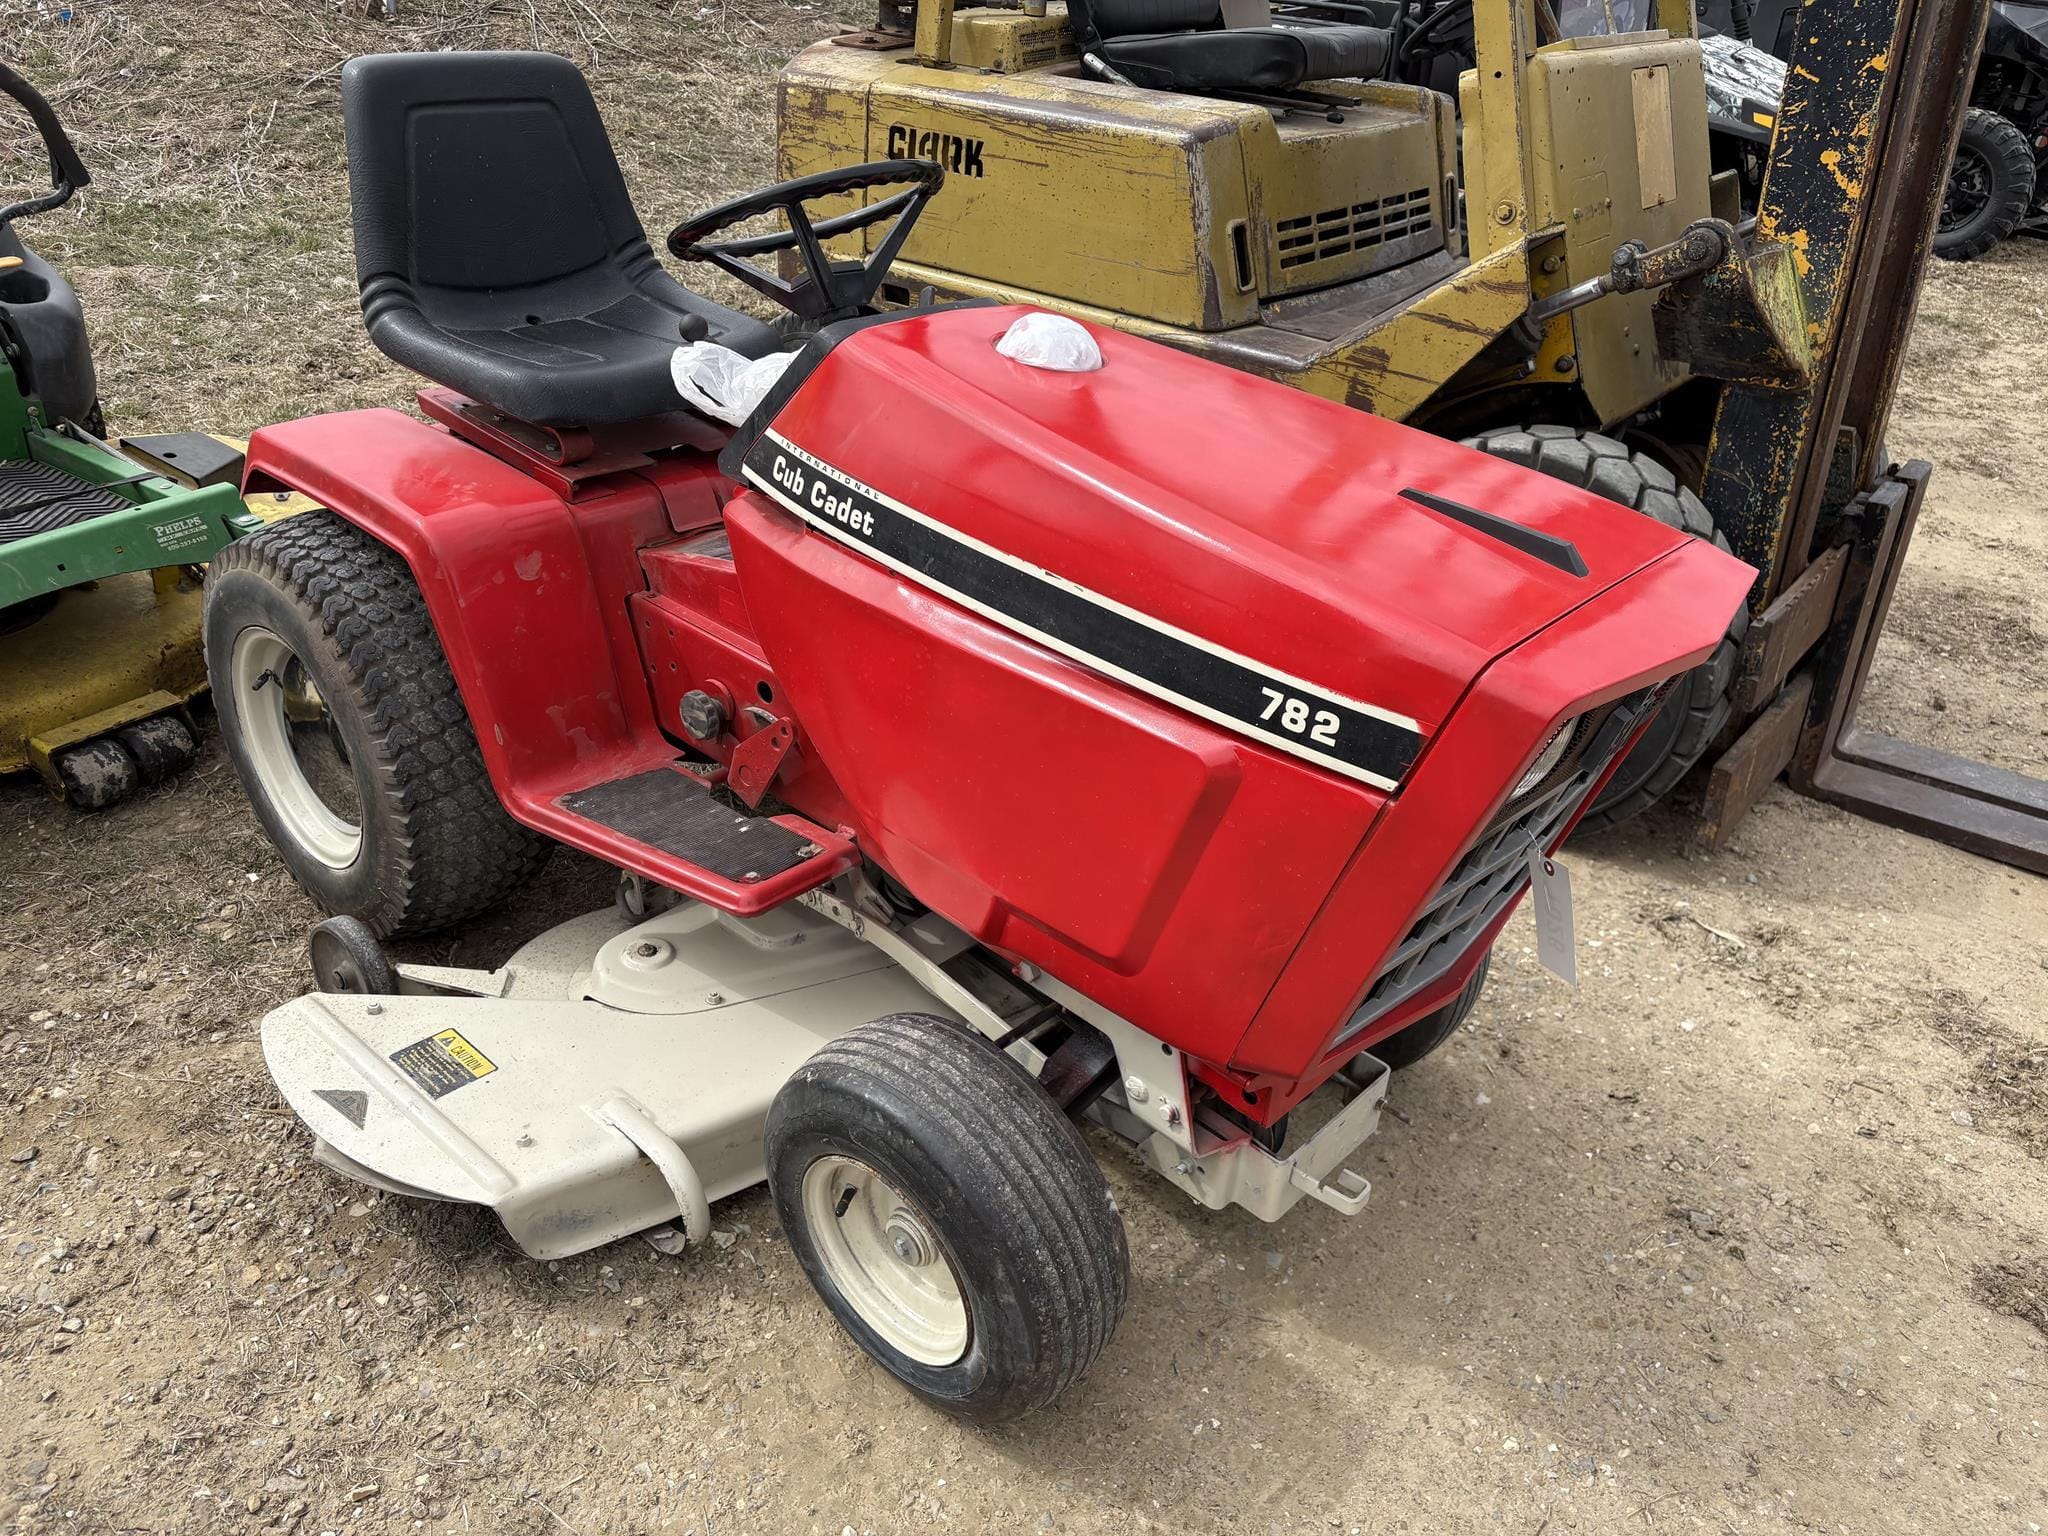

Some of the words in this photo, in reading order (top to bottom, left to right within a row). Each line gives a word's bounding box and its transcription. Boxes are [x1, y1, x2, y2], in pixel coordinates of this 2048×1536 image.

[772, 455, 805, 496] Cub
[810, 480, 875, 537] Cadet
[781, 438, 880, 500] INTERNATIONAL
[153, 516, 202, 537] PHELPS
[1259, 686, 1341, 748] 782
[450, 1045, 484, 1071] CAUTION
